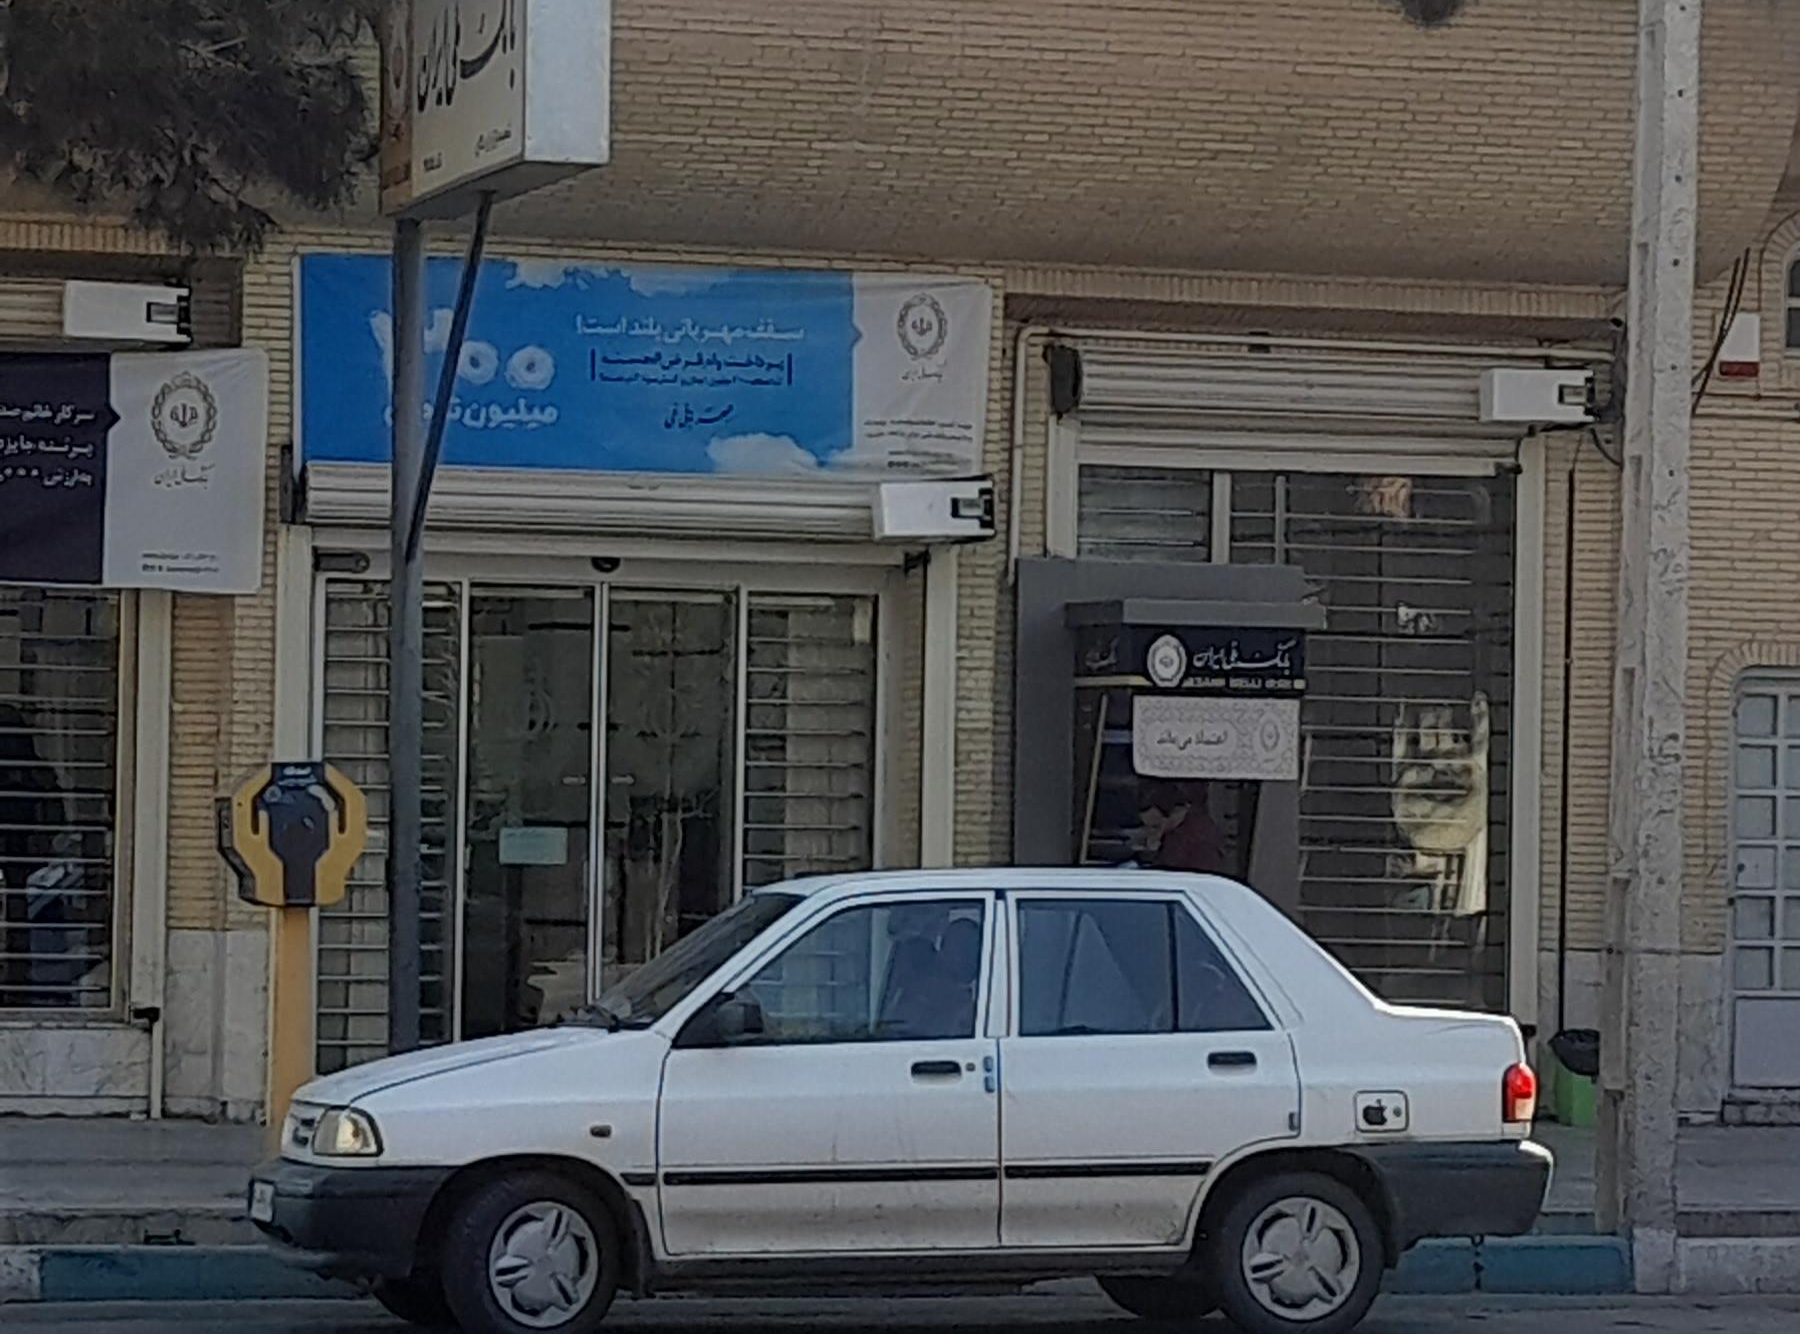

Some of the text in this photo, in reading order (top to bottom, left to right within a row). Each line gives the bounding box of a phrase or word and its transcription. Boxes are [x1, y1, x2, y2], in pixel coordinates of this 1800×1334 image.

[627, 315, 663, 343] بلند
[663, 317, 746, 346] مهربانی
[462, 396, 559, 430] میلیون
